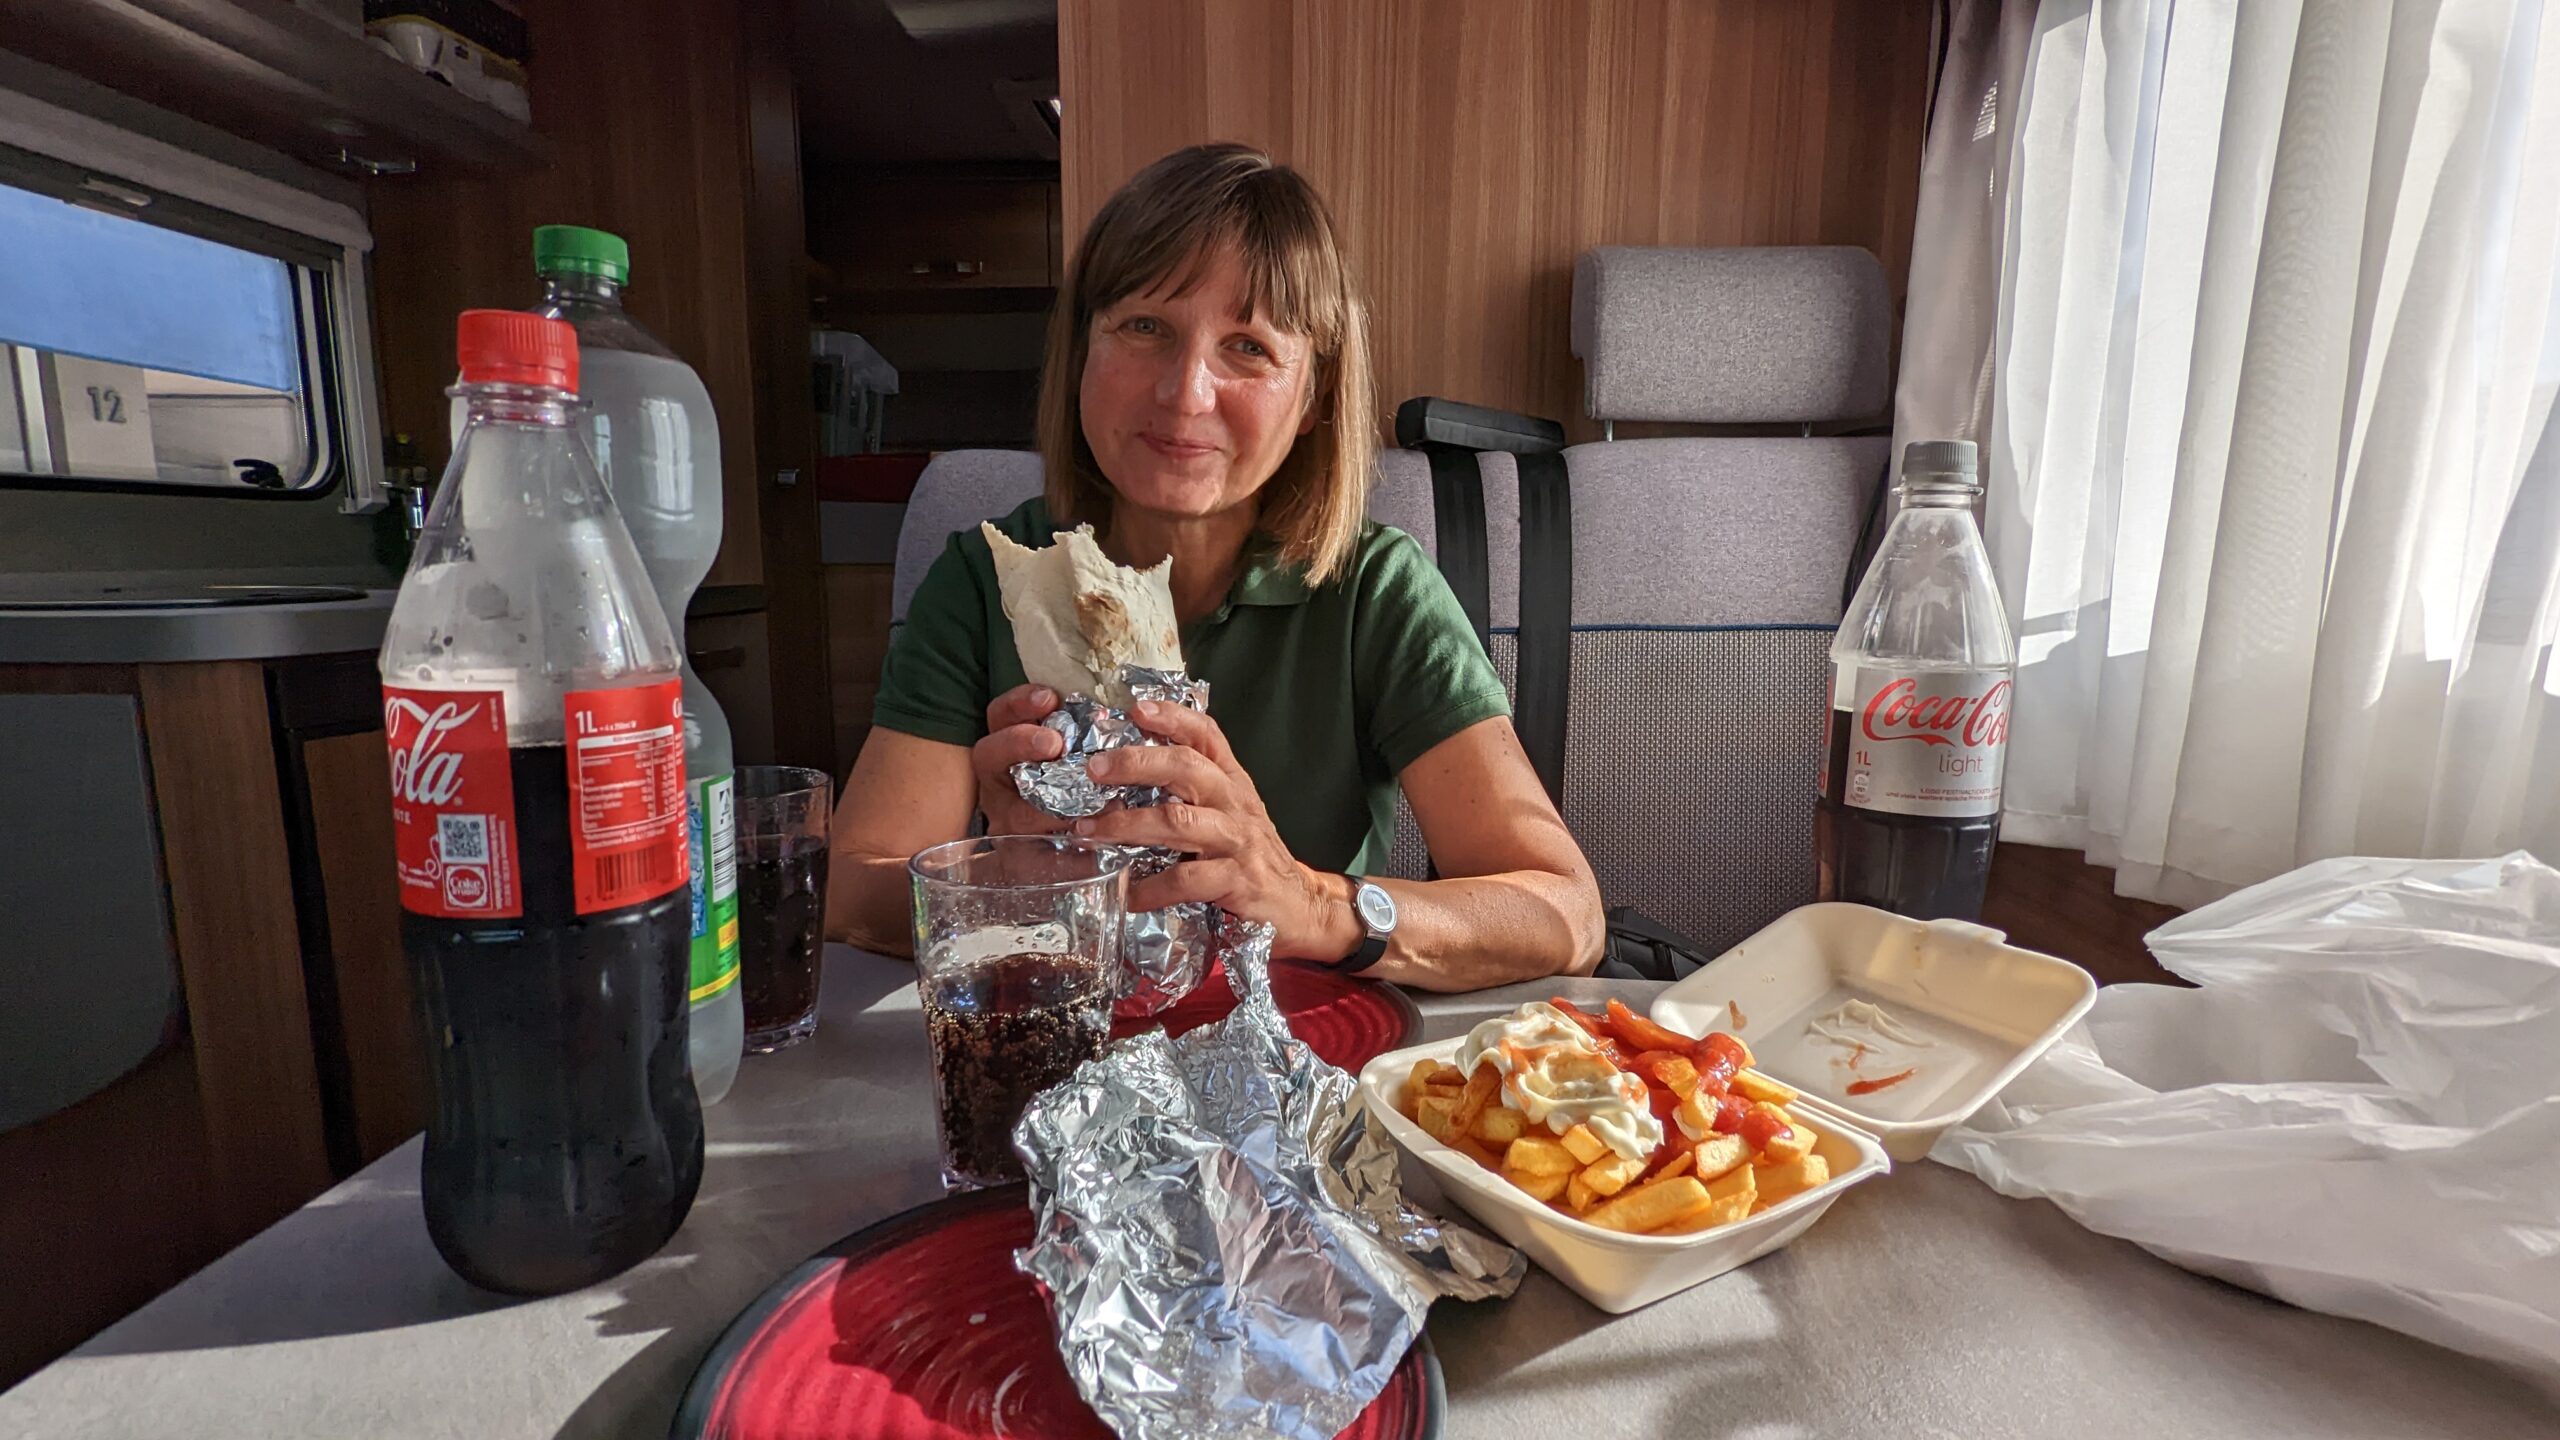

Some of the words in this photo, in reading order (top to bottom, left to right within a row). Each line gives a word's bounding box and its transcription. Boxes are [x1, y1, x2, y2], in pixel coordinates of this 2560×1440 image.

[87, 386, 127, 424] 12
[575, 710, 598, 734] 1L
[1862, 677, 2012, 748] Coca-Col
[1855, 750, 1872, 767] 1L
[1939, 750, 1984, 777] light
[450, 876, 480, 889] Coke
